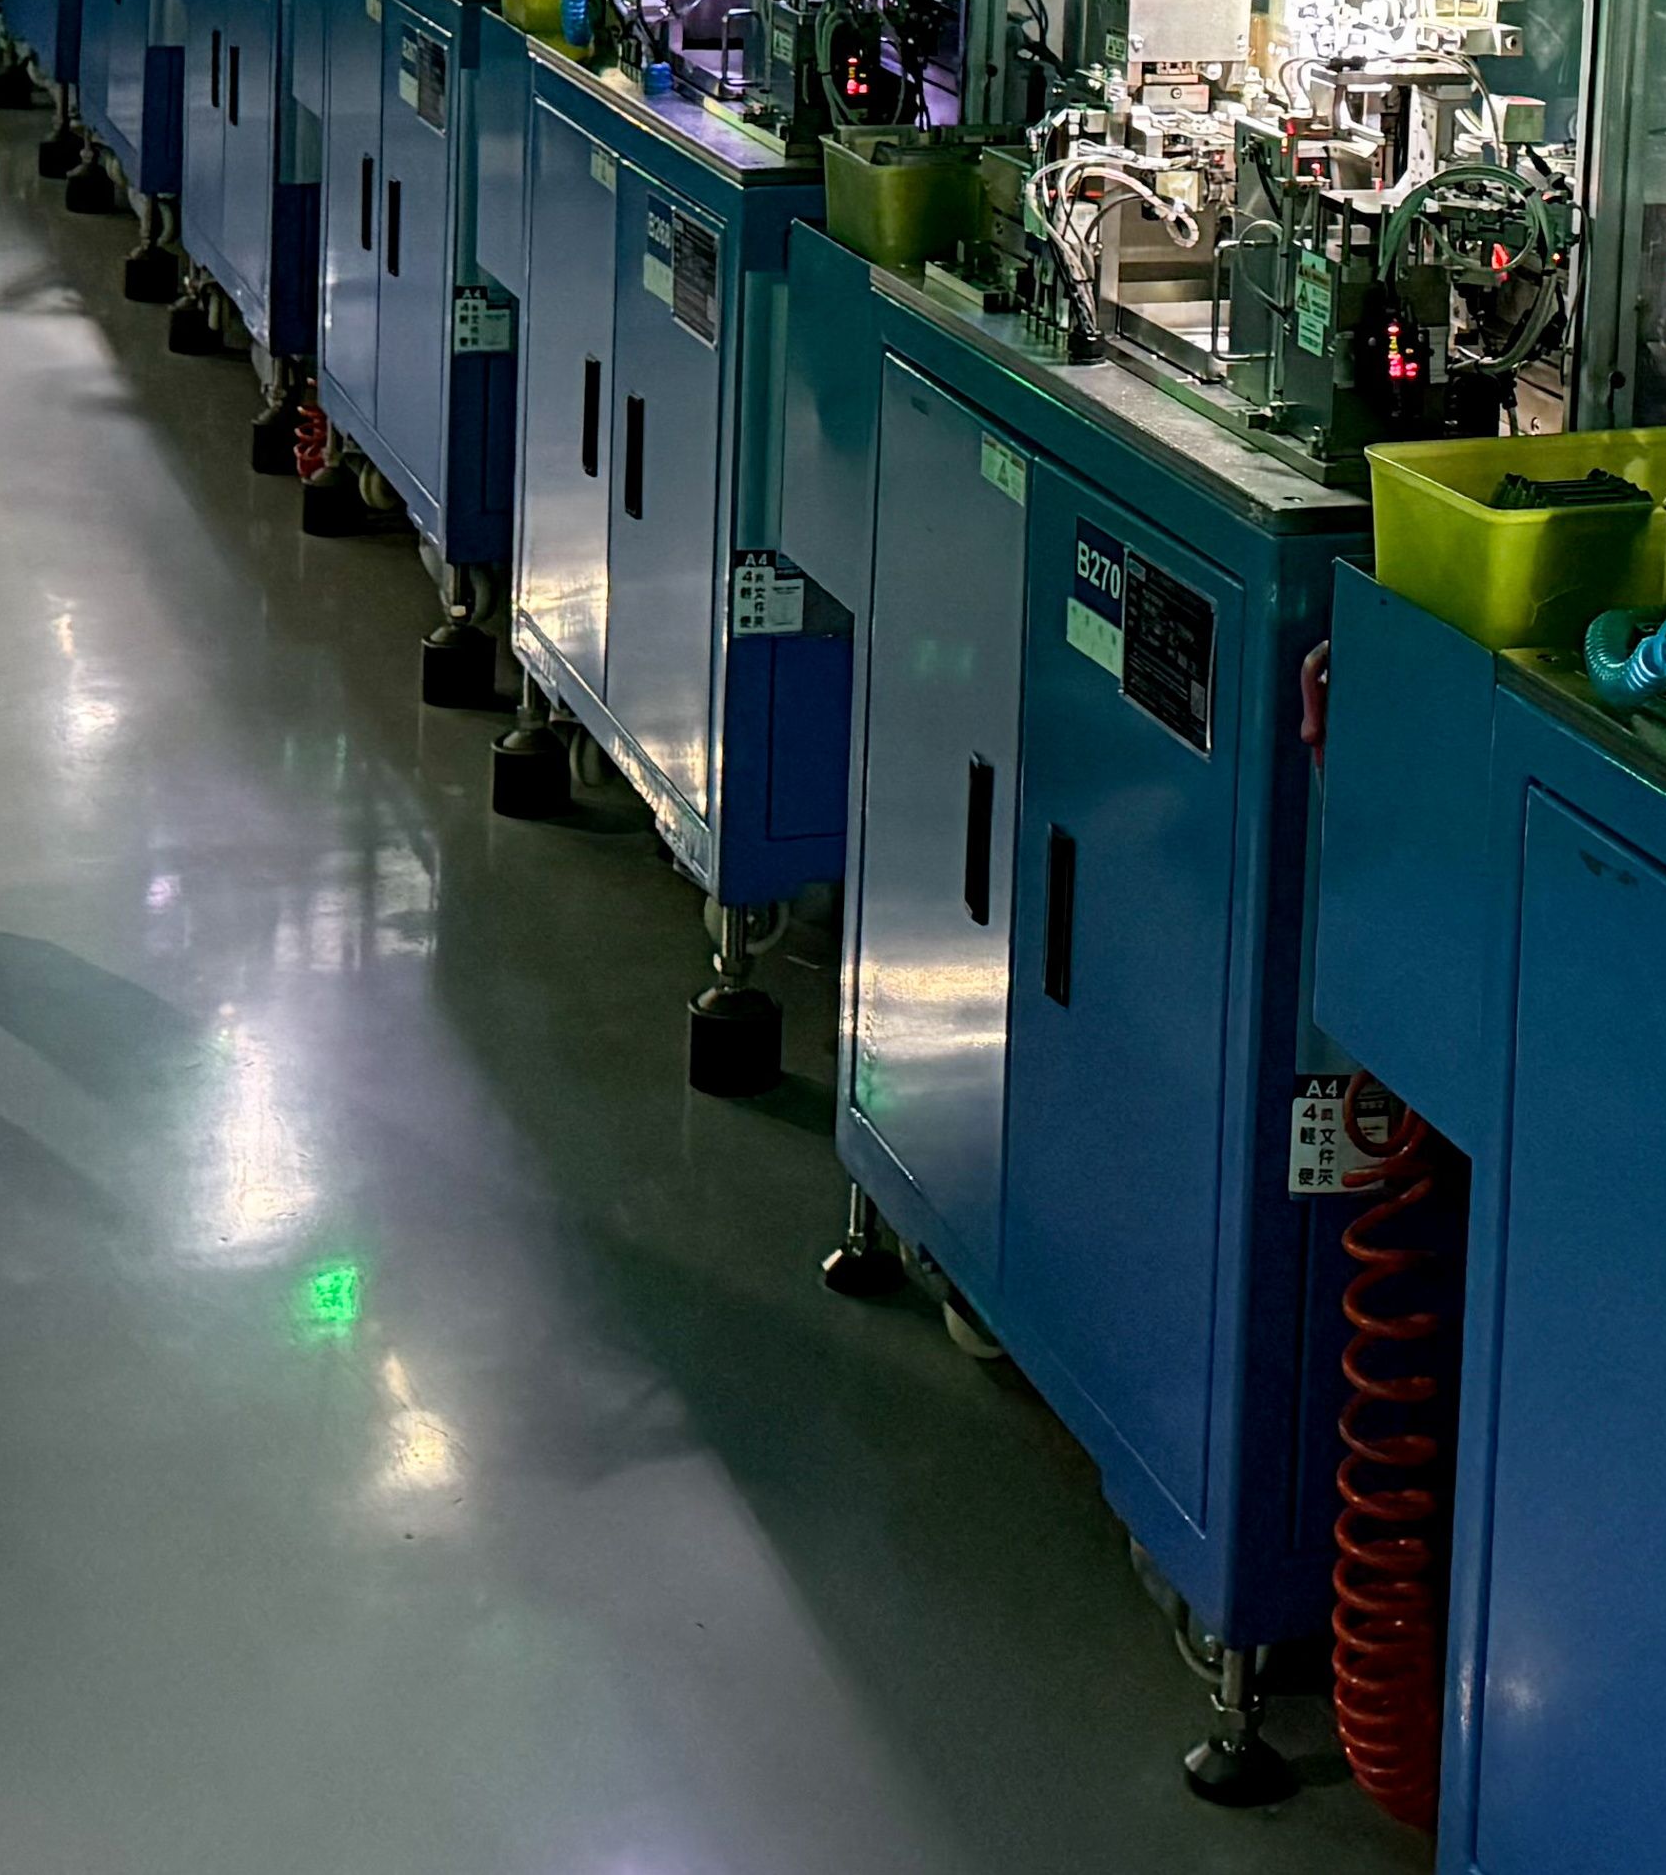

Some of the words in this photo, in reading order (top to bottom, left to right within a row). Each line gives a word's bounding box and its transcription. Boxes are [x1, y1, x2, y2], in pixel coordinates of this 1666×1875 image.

[745, 553, 768, 566] A4
[1077, 540, 1121, 600] B270
[1306, 1079, 1338, 1097] A4
